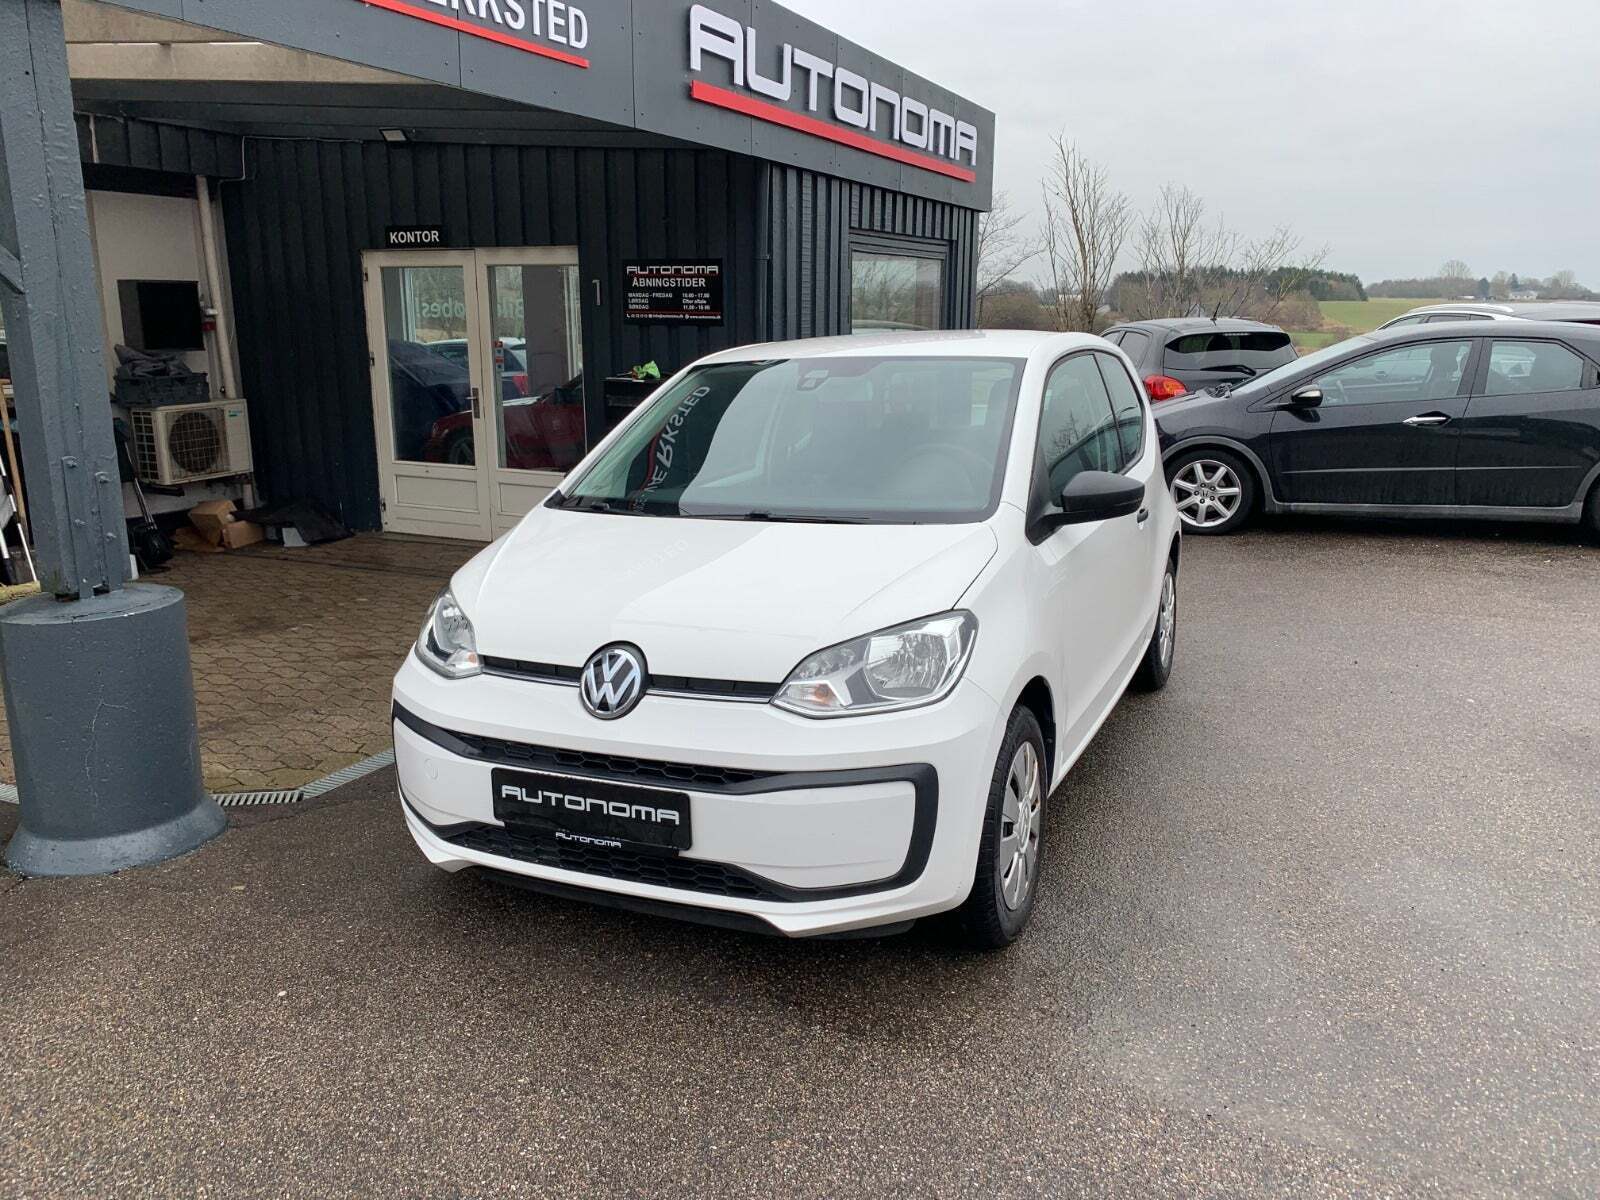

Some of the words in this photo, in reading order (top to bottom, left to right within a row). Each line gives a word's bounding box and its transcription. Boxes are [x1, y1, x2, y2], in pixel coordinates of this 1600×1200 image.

[690, 4, 978, 167] AUTONOMA
[389, 230, 440, 244] KONTOR
[626, 265, 719, 275] AUTONOMA
[632, 277, 706, 288] ÅBNINGSTIDER
[501, 784, 680, 825] AUTONOMA
[555, 831, 622, 849] AUTONOMA
